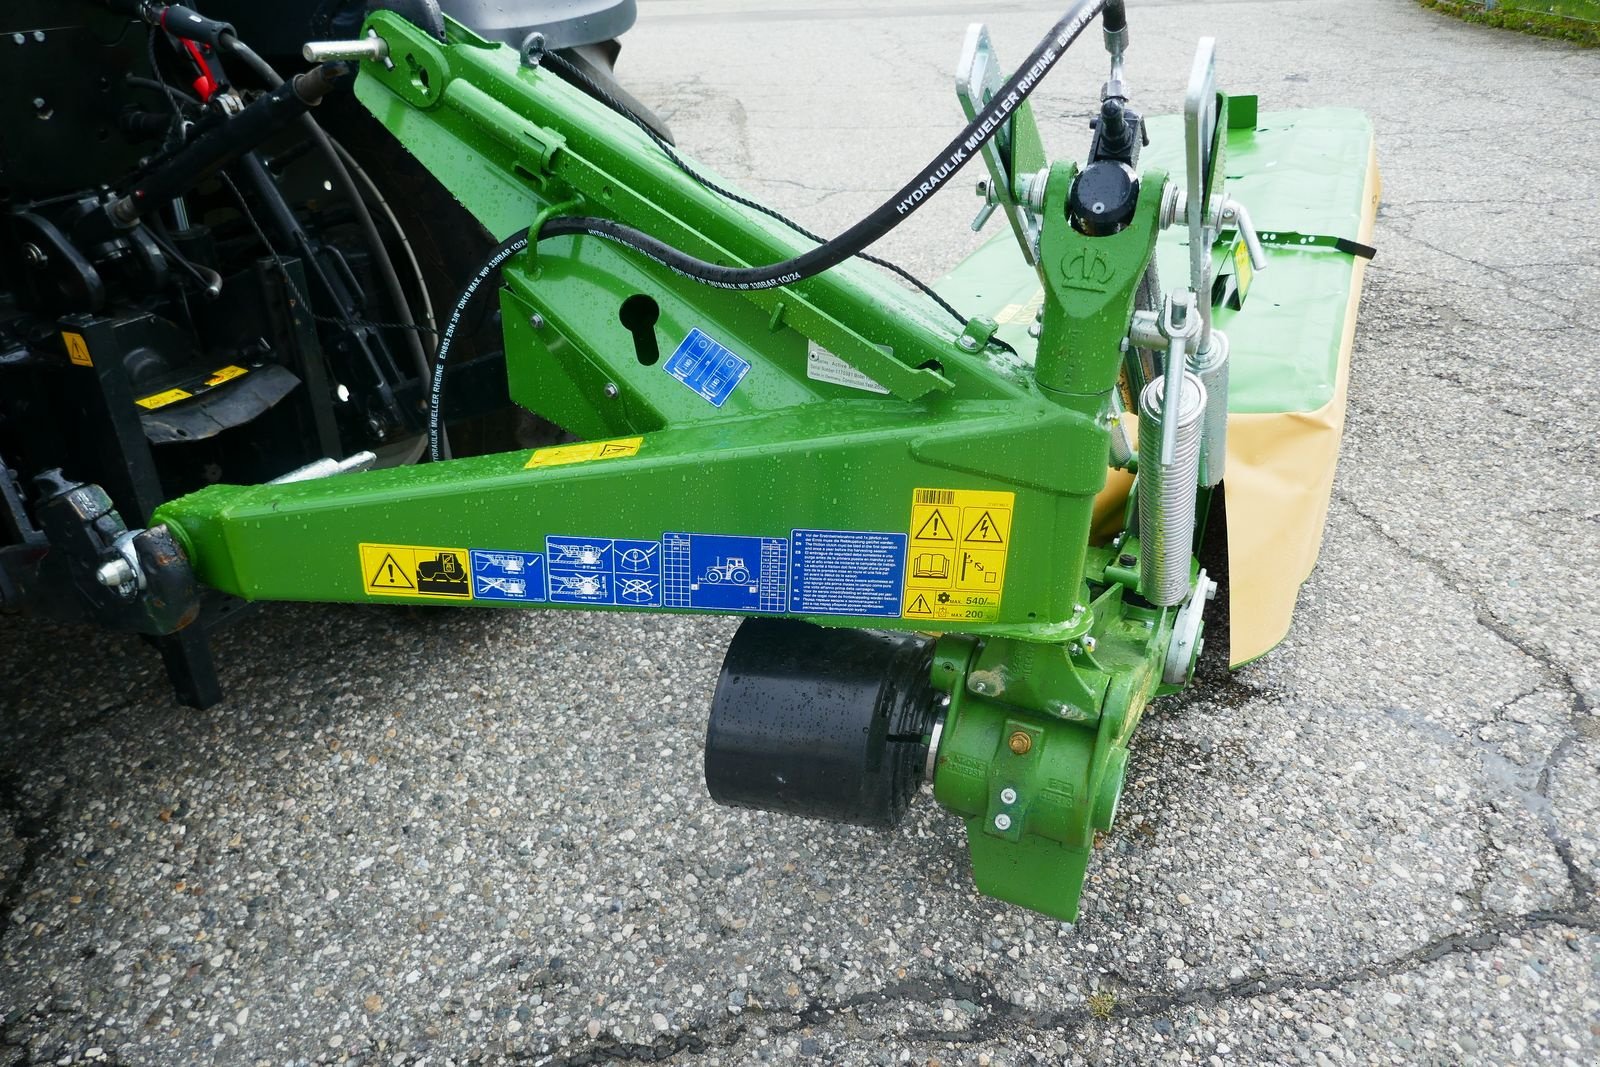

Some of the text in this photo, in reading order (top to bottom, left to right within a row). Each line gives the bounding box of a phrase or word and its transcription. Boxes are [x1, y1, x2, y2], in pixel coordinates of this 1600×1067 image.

[896, 147, 968, 214] HYDRAULIK
[964, 91, 1020, 152] MUELLER
[1016, 48, 1056, 95] RHEINE
[490, 248, 512, 270] 330BAR
[480, 265, 492, 278] WP
[778, 272, 801, 284] 1Q/24
[458, 292, 472, 310] DN10
[447, 323, 456, 341] 2SN
[440, 338, 452, 360] EN853
[432, 364, 444, 392] RHEINE
[430, 394, 440, 428] MUELLER
[965, 610, 983, 618] 200
